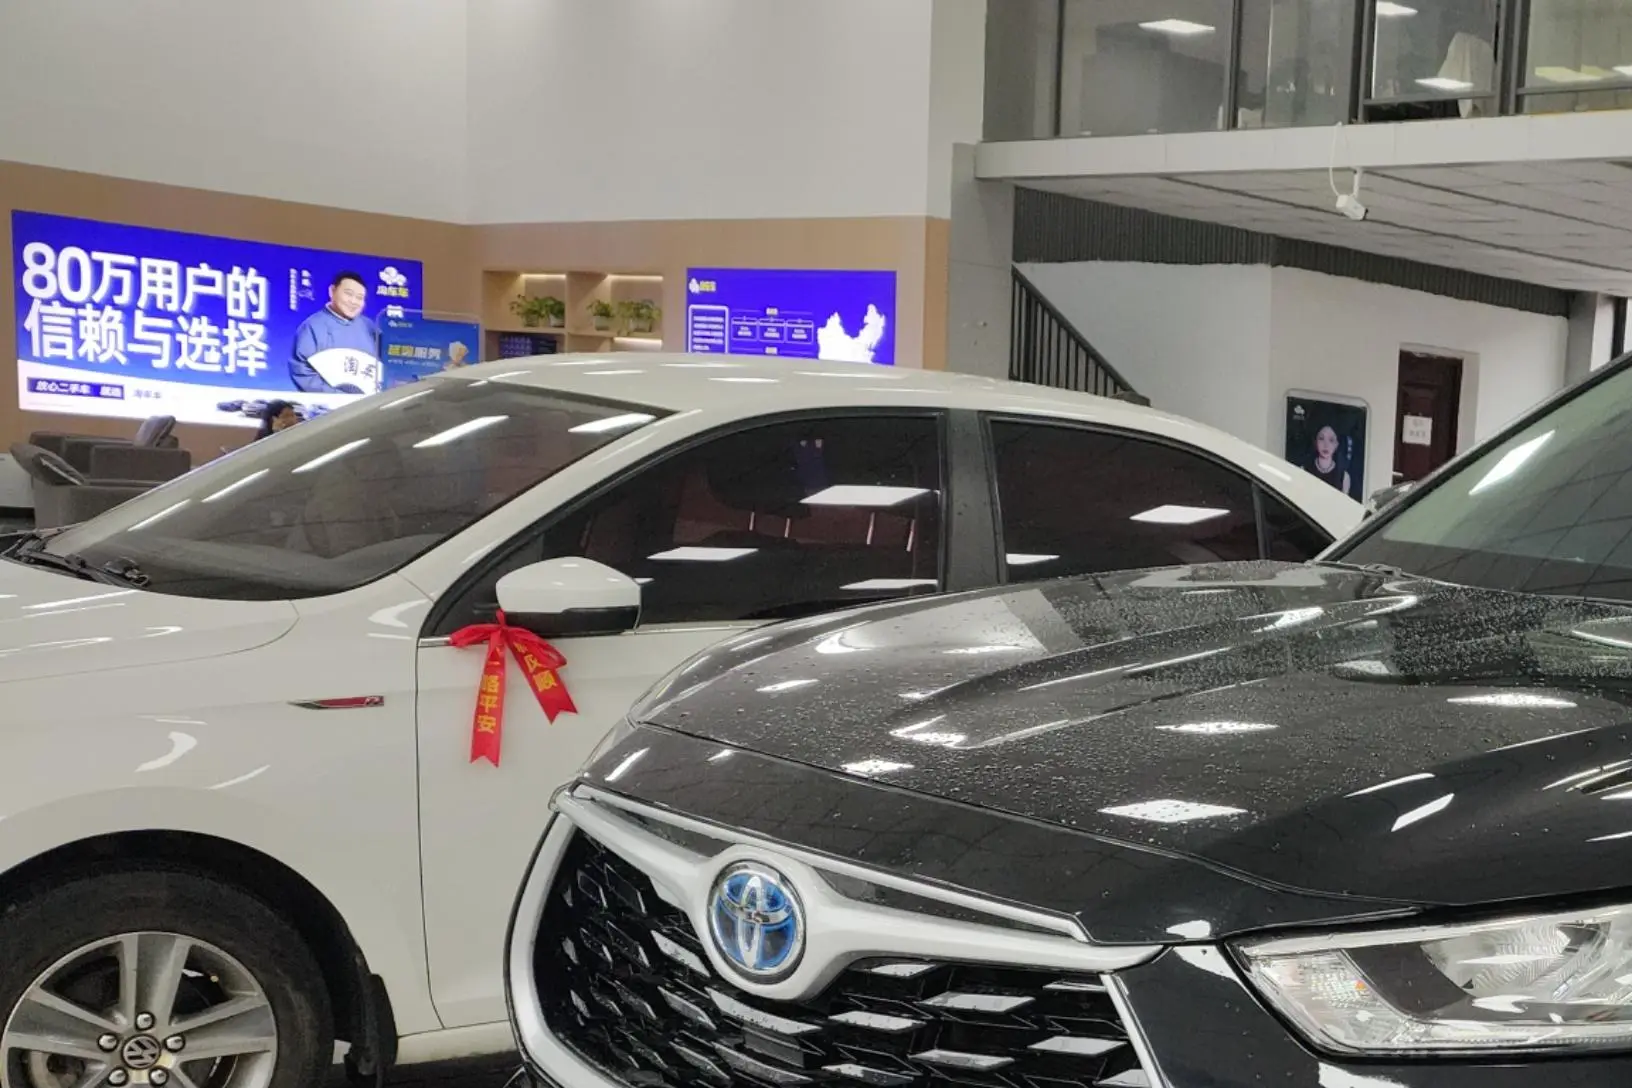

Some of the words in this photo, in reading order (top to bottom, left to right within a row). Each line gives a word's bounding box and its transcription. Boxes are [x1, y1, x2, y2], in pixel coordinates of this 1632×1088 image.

[22, 241, 268, 319] 80万用户的
[23, 298, 269, 376] 信赖与选择
